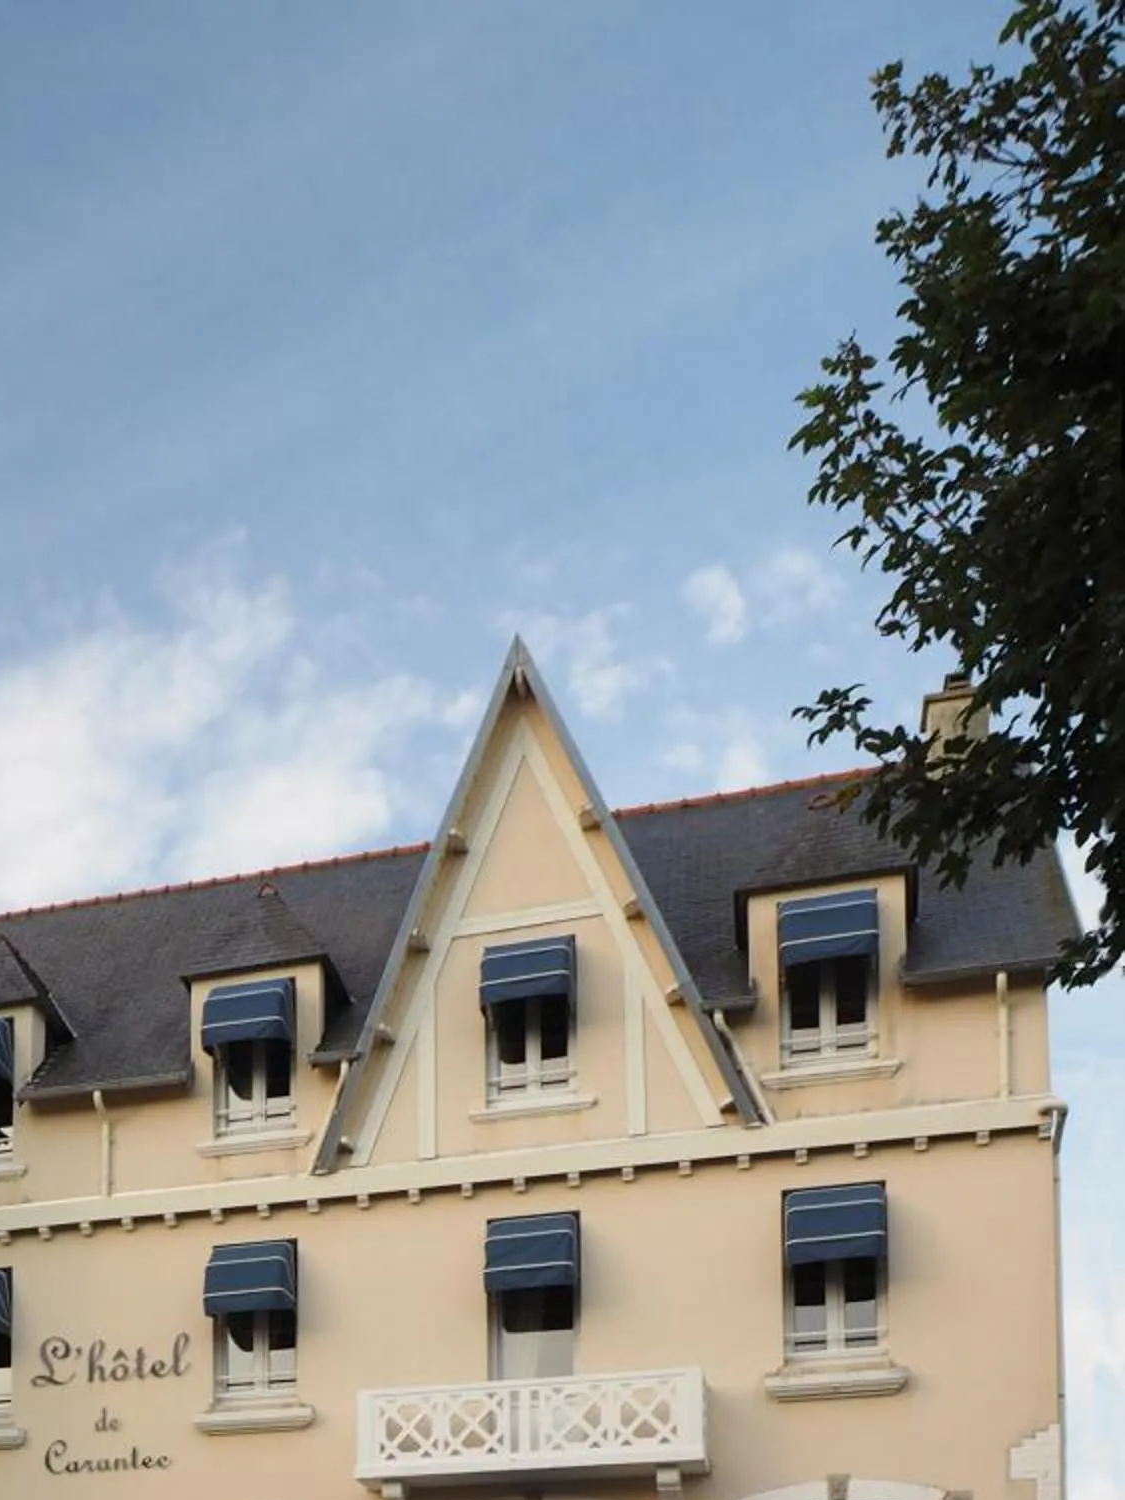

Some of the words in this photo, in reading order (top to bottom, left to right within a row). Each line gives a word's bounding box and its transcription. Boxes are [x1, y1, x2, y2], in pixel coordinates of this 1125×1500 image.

[30, 1332, 192, 1387] L'hôtel
[94, 1407, 121, 1433] de
[44, 1439, 172, 1475] Carantec
